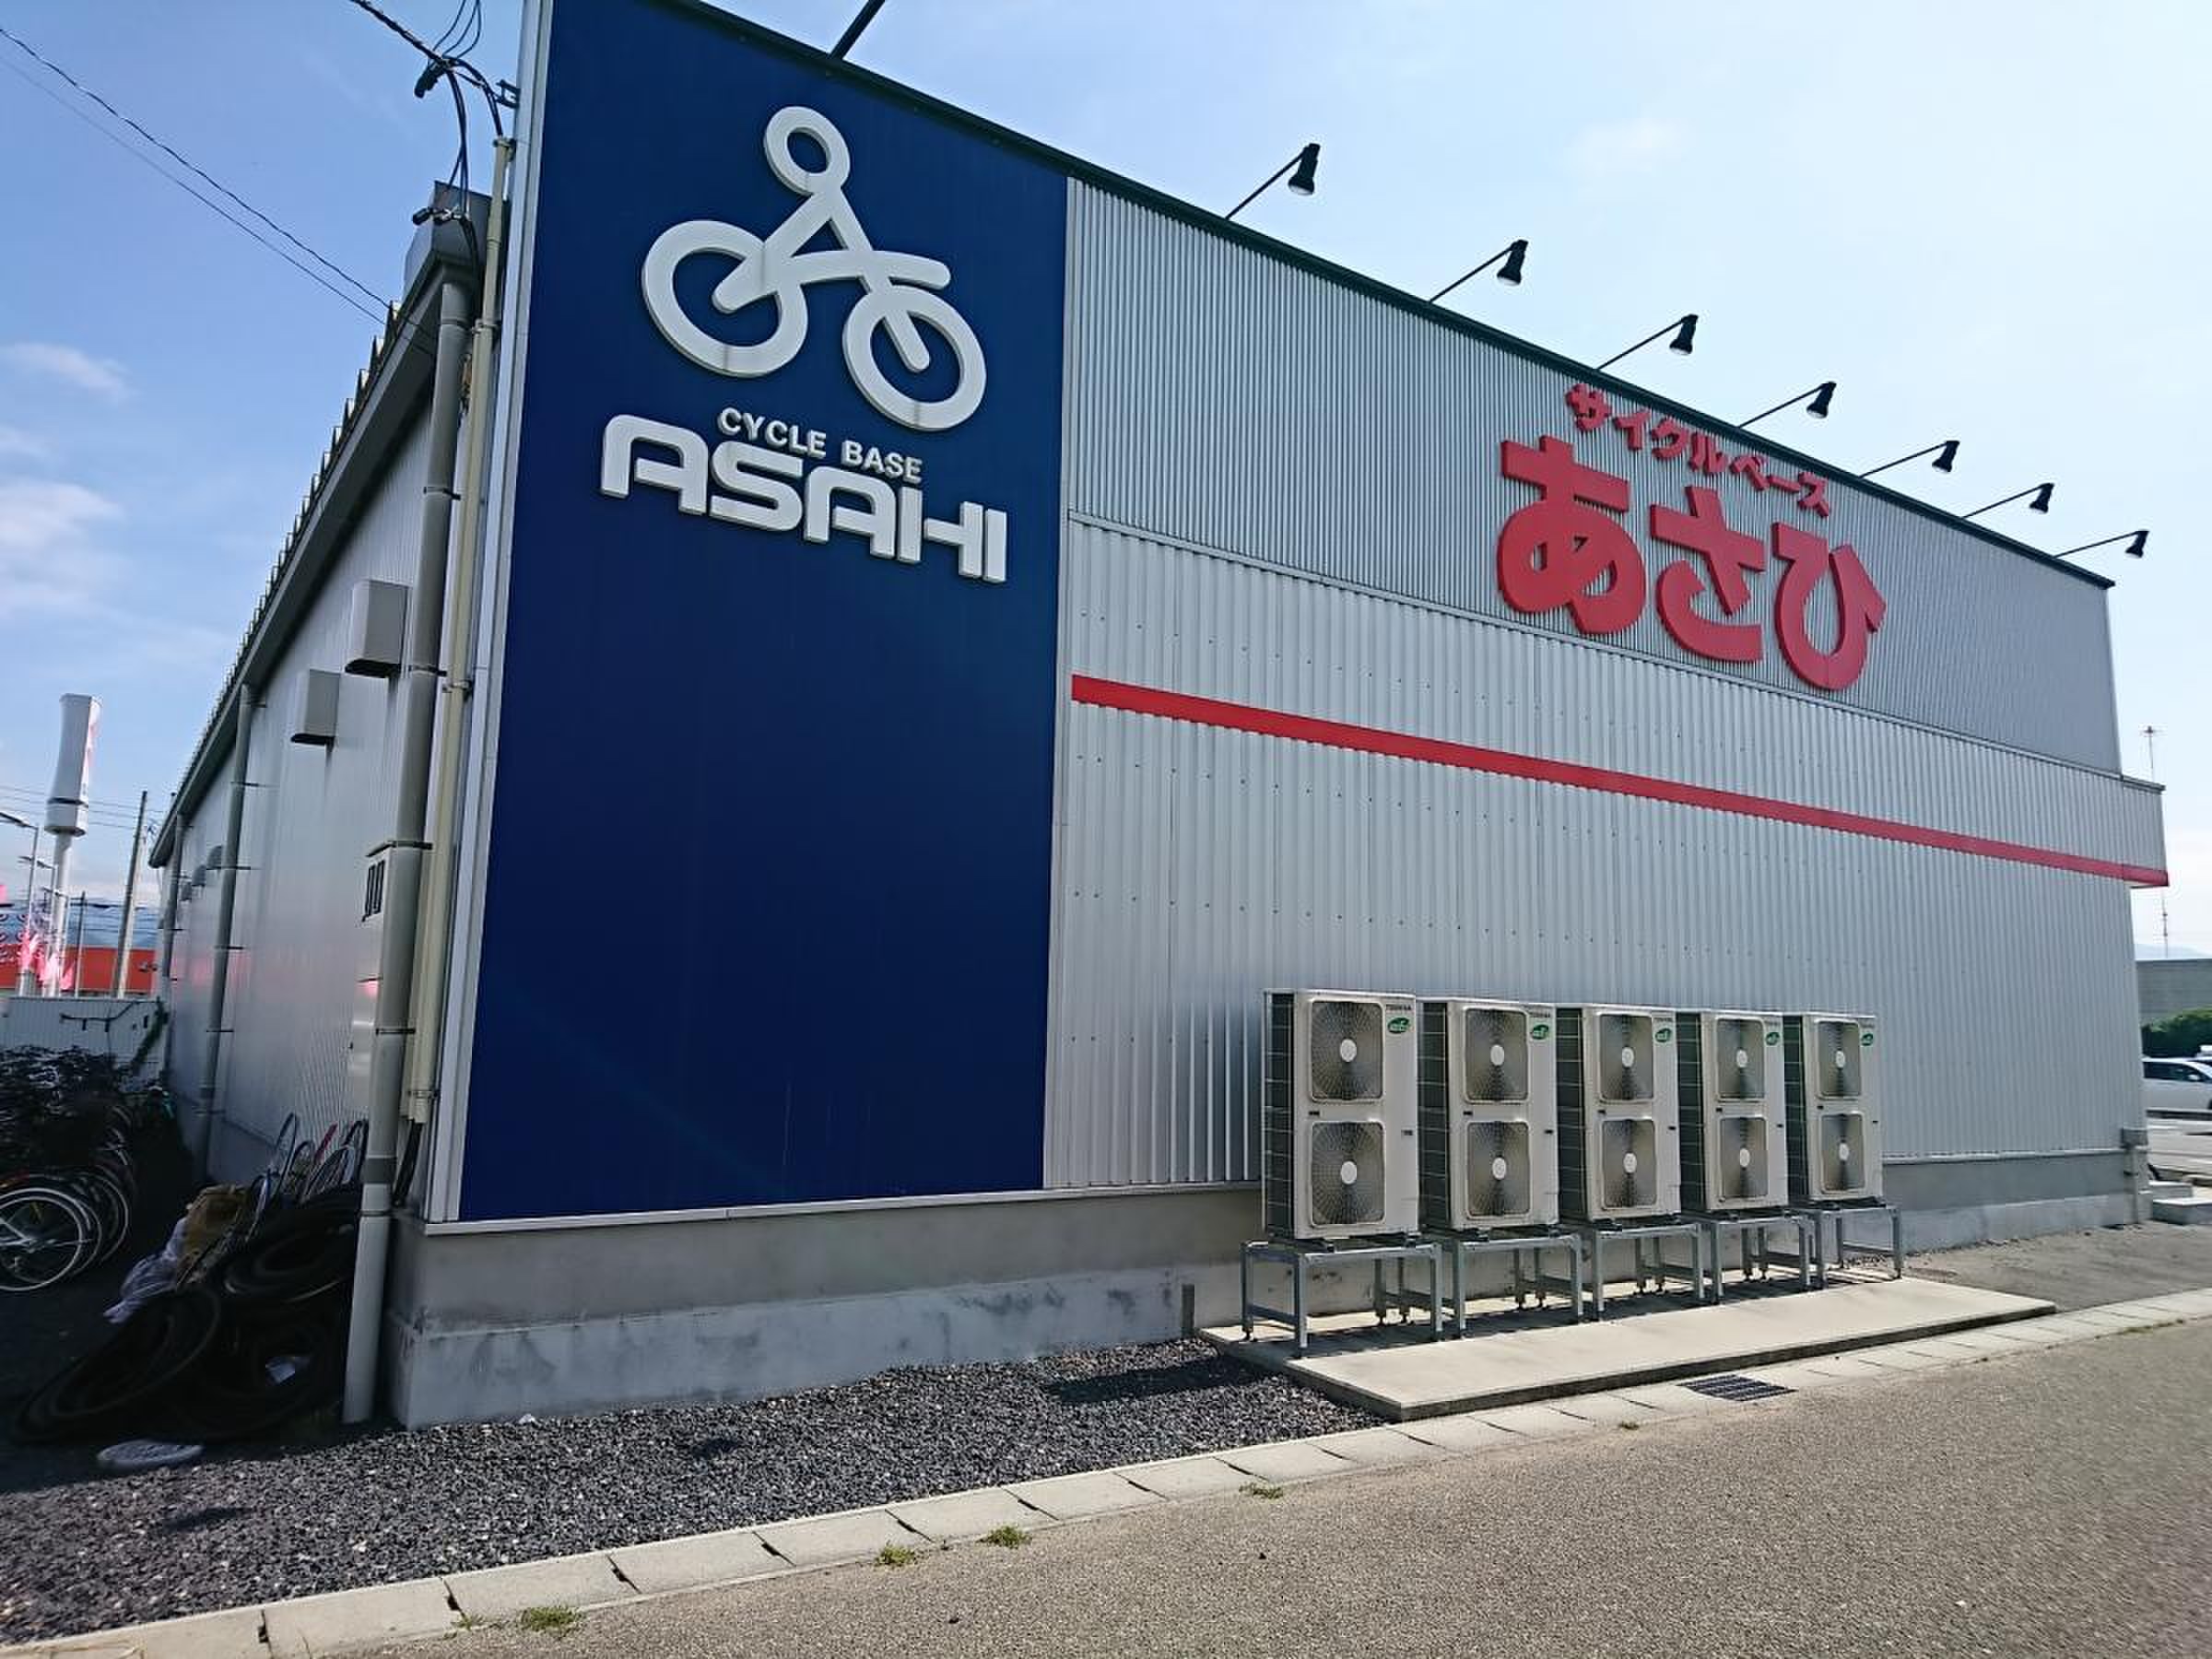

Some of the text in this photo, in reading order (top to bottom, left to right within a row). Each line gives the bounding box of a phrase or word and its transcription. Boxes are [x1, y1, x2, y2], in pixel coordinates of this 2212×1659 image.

[601, 414, 1007, 582] ASAHI
[718, 407, 923, 482] CYCLE BASE
[1567, 383, 1830, 517] サイクルベース
[1497, 436, 1887, 690] あさひ
